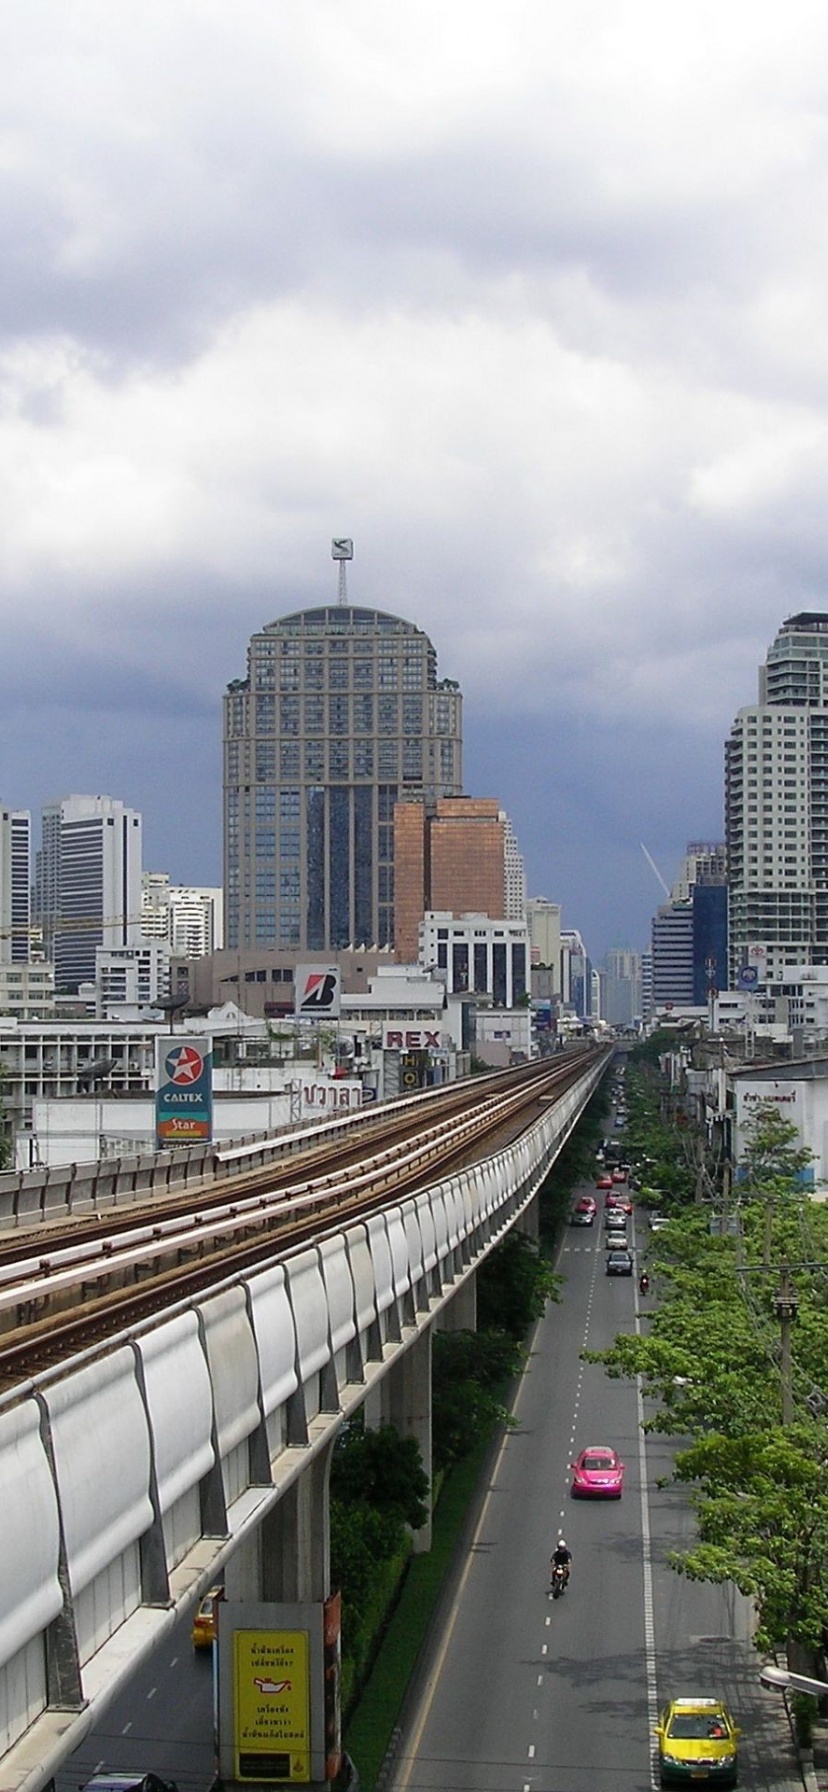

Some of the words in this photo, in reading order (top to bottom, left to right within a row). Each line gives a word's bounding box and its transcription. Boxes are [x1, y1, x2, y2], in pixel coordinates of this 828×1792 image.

[387, 1031, 440, 1048] REX
[163, 1093, 203, 1102] CALTEX
[172, 1118, 195, 1131] Star
